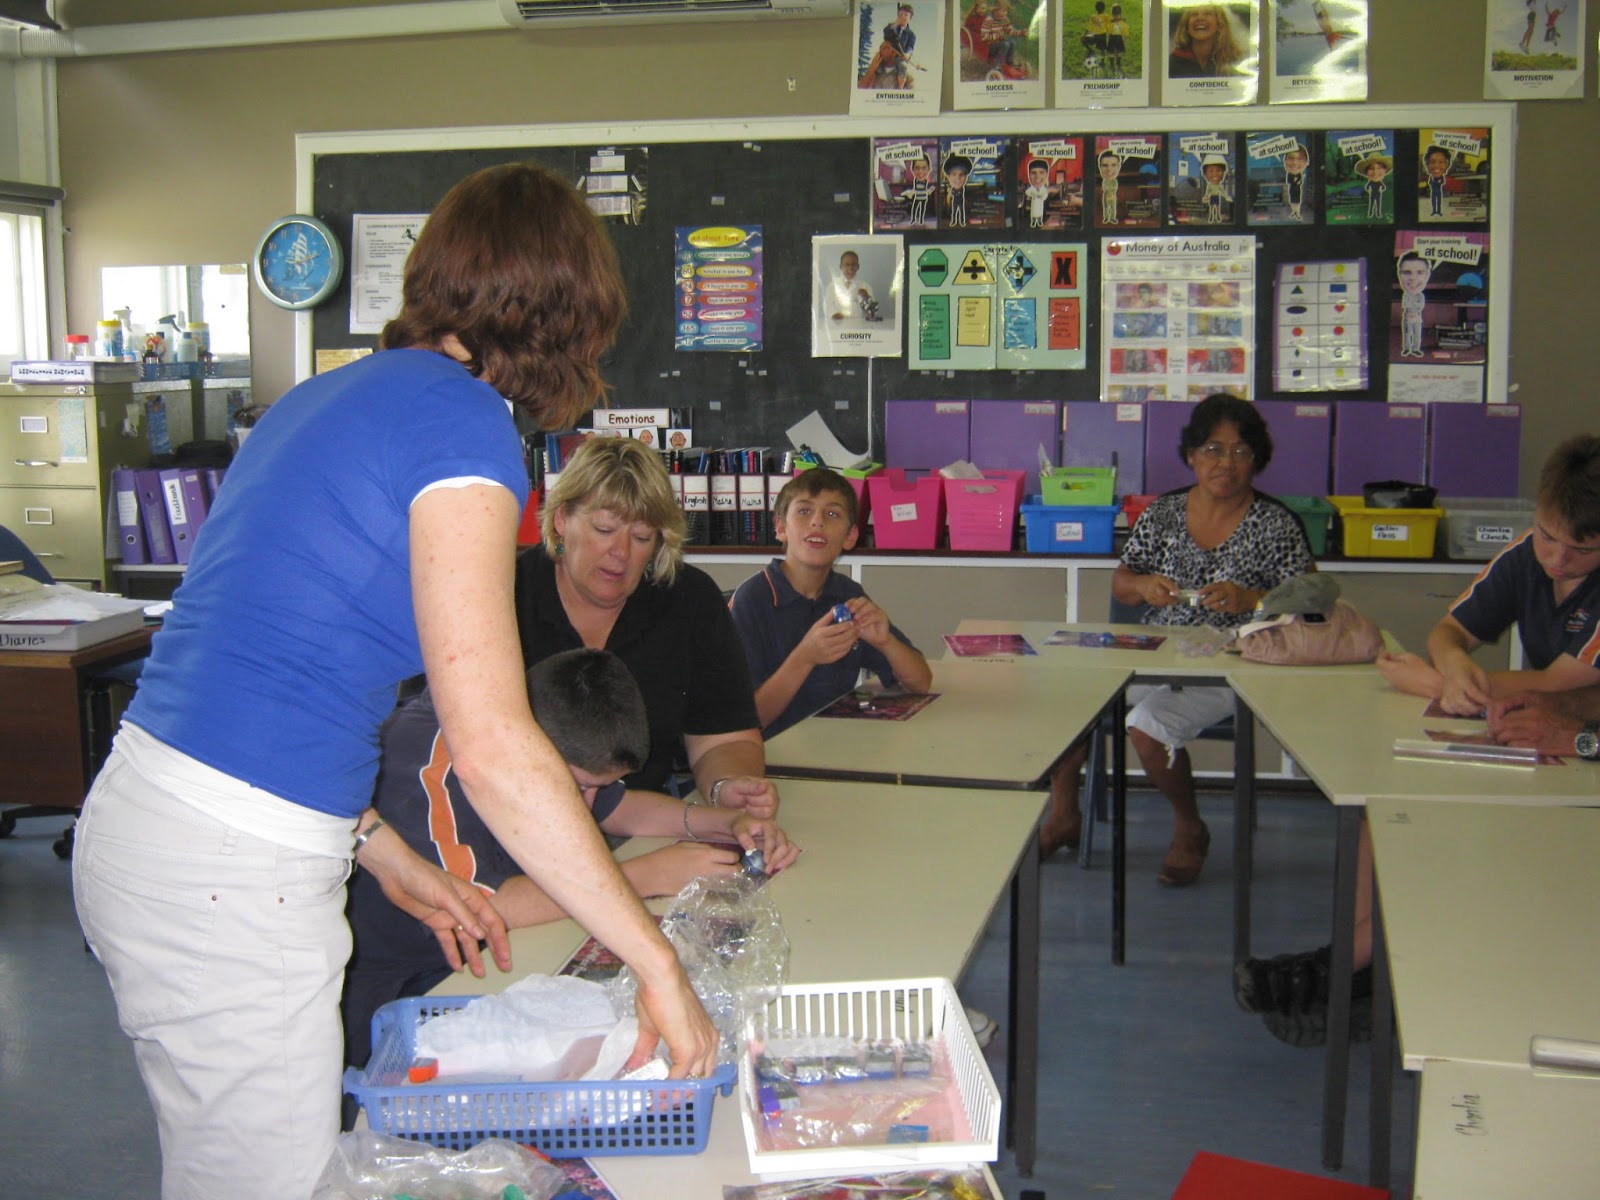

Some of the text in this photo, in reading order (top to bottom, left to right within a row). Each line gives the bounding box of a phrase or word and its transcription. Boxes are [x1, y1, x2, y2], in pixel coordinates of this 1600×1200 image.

[986, 84, 1013, 92] SUCCESS
[1083, 83, 1121, 91] FRIENDSHIP
[1197, 142, 1226, 152] school!
[1258, 140, 1294, 157] at school!
[1345, 138, 1381, 154] at school!
[1439, 138, 1477, 152] at school!
[885, 150, 920, 160] at school!
[959, 146, 995, 155] at school!
[1036, 146, 1072, 156] at school!
[1116, 146, 1153, 156] at school!
[1126, 241, 1230, 254] Money of Australia
[1424, 247, 1477, 261] at school!
[609, 414, 655, 424] Emotions
[684, 495, 707, 507] English
[713, 496, 732, 505] Maths
[742, 497, 762, 506] Maths
[0, 634, 46, 647] Diaries
